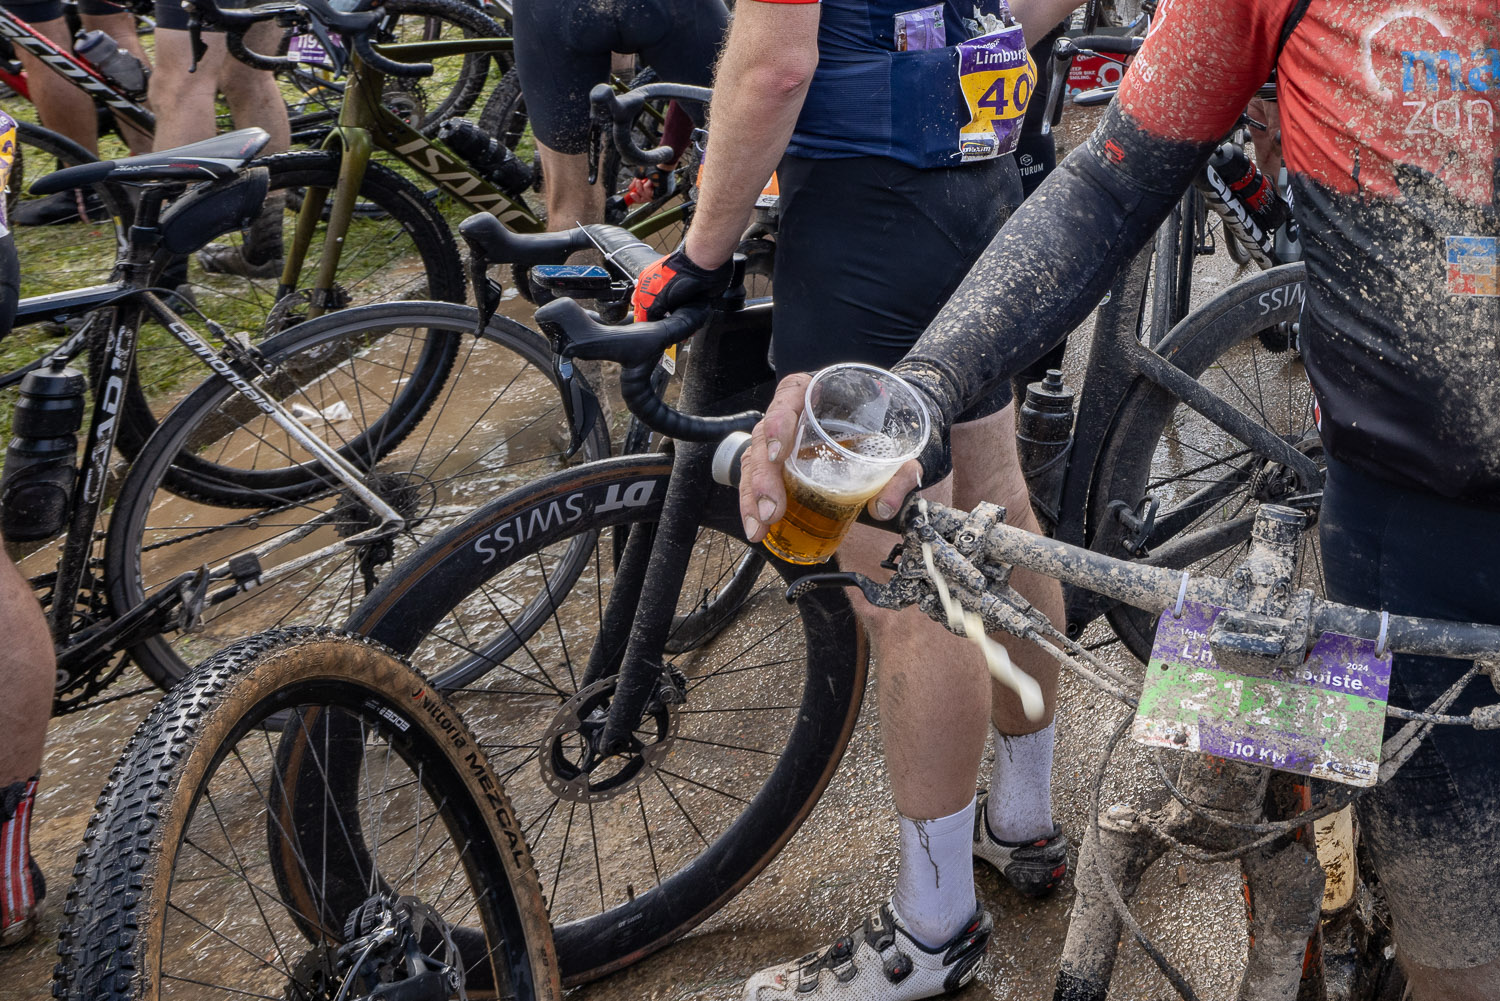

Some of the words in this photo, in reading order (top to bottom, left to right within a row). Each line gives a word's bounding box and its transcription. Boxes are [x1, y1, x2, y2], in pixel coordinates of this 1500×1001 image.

[976, 47, 1027, 65] Limburg
[169, 322, 275, 414] cannondale
[594, 480, 657, 514] DT
[474, 492, 584, 565] SWISS
[1296, 669, 1363, 691] ooiste
[1346, 662, 1369, 672] 2024
[418, 693, 466, 750] Vittoria
[1229, 740, 1255, 757] 110
[1259, 748, 1287, 764] KM
[465, 751, 529, 869] MEZCAL
